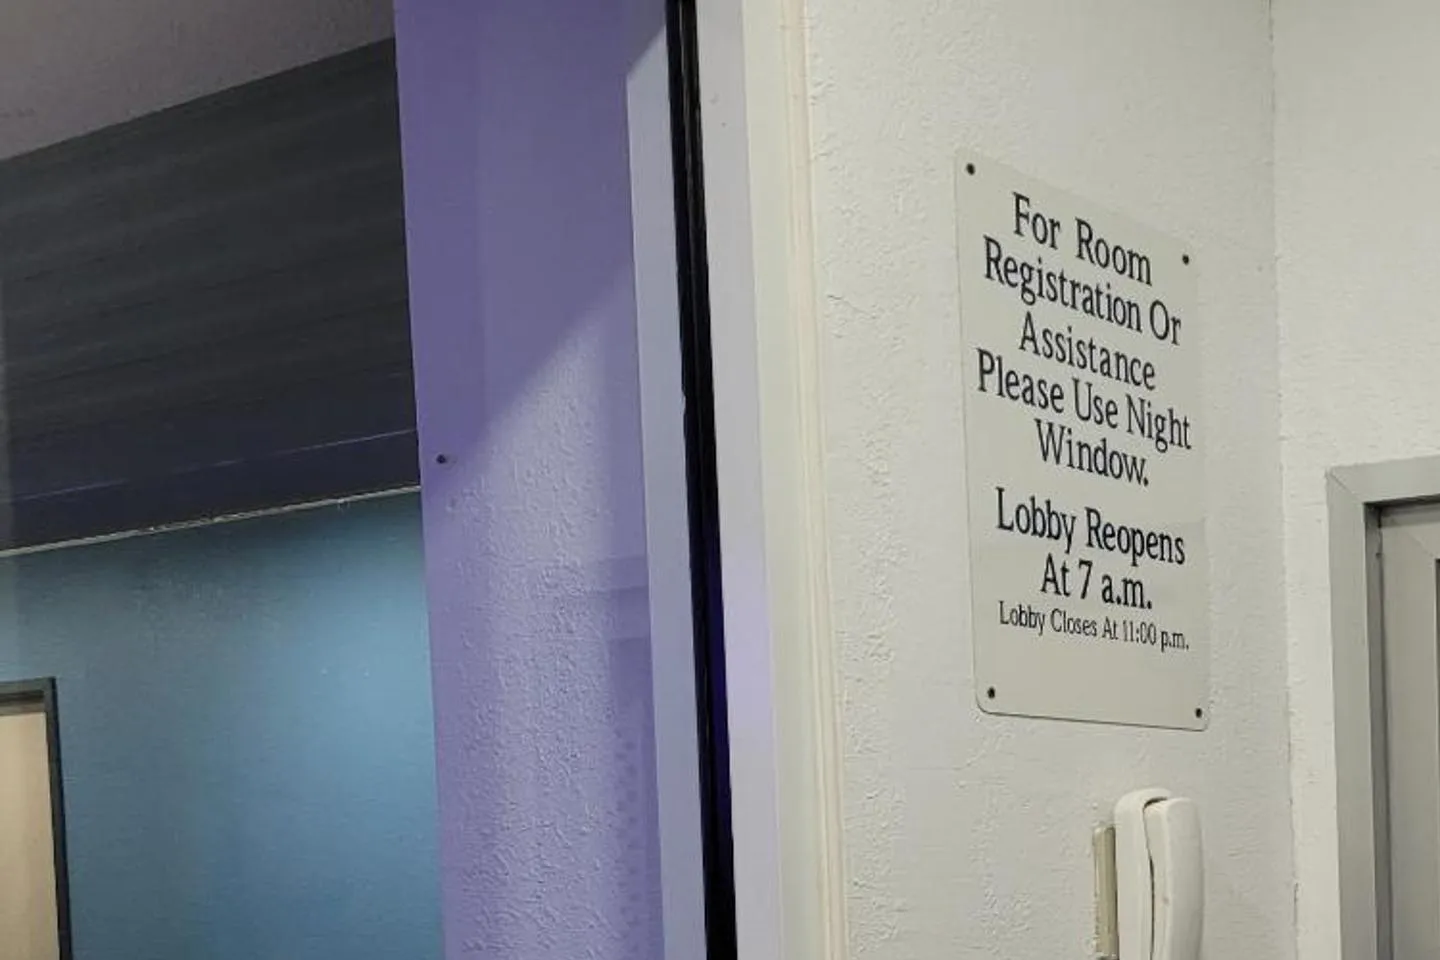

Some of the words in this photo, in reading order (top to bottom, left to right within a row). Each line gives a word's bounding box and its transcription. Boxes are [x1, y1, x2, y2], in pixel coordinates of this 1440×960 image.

[1013, 191, 1061, 250] For
[1075, 217, 1152, 286] Room
[983, 235, 1142, 333] Registration
[1150, 300, 1181, 345] Or
[1019, 311, 1155, 390] Assistance
[977, 348, 1064, 413] Please
[1073, 378, 1118, 428] Use
[1126, 394, 1191, 453] Night
[1035, 418, 1149, 486] Window.
[995, 486, 1076, 554] Lobby
[1085, 507, 1186, 566] Reopens
[1041, 553, 1070, 597] At
[1079, 559, 1093, 599] 7
[1102, 574, 1152, 609] a.m.
[999, 600, 1046, 636] Lobby
[1050, 608, 1097, 637] Closes
[1102, 616, 1119, 640] At
[1123, 621, 1156, 645] 11:00
[1161, 630, 1189, 652] p.m.
